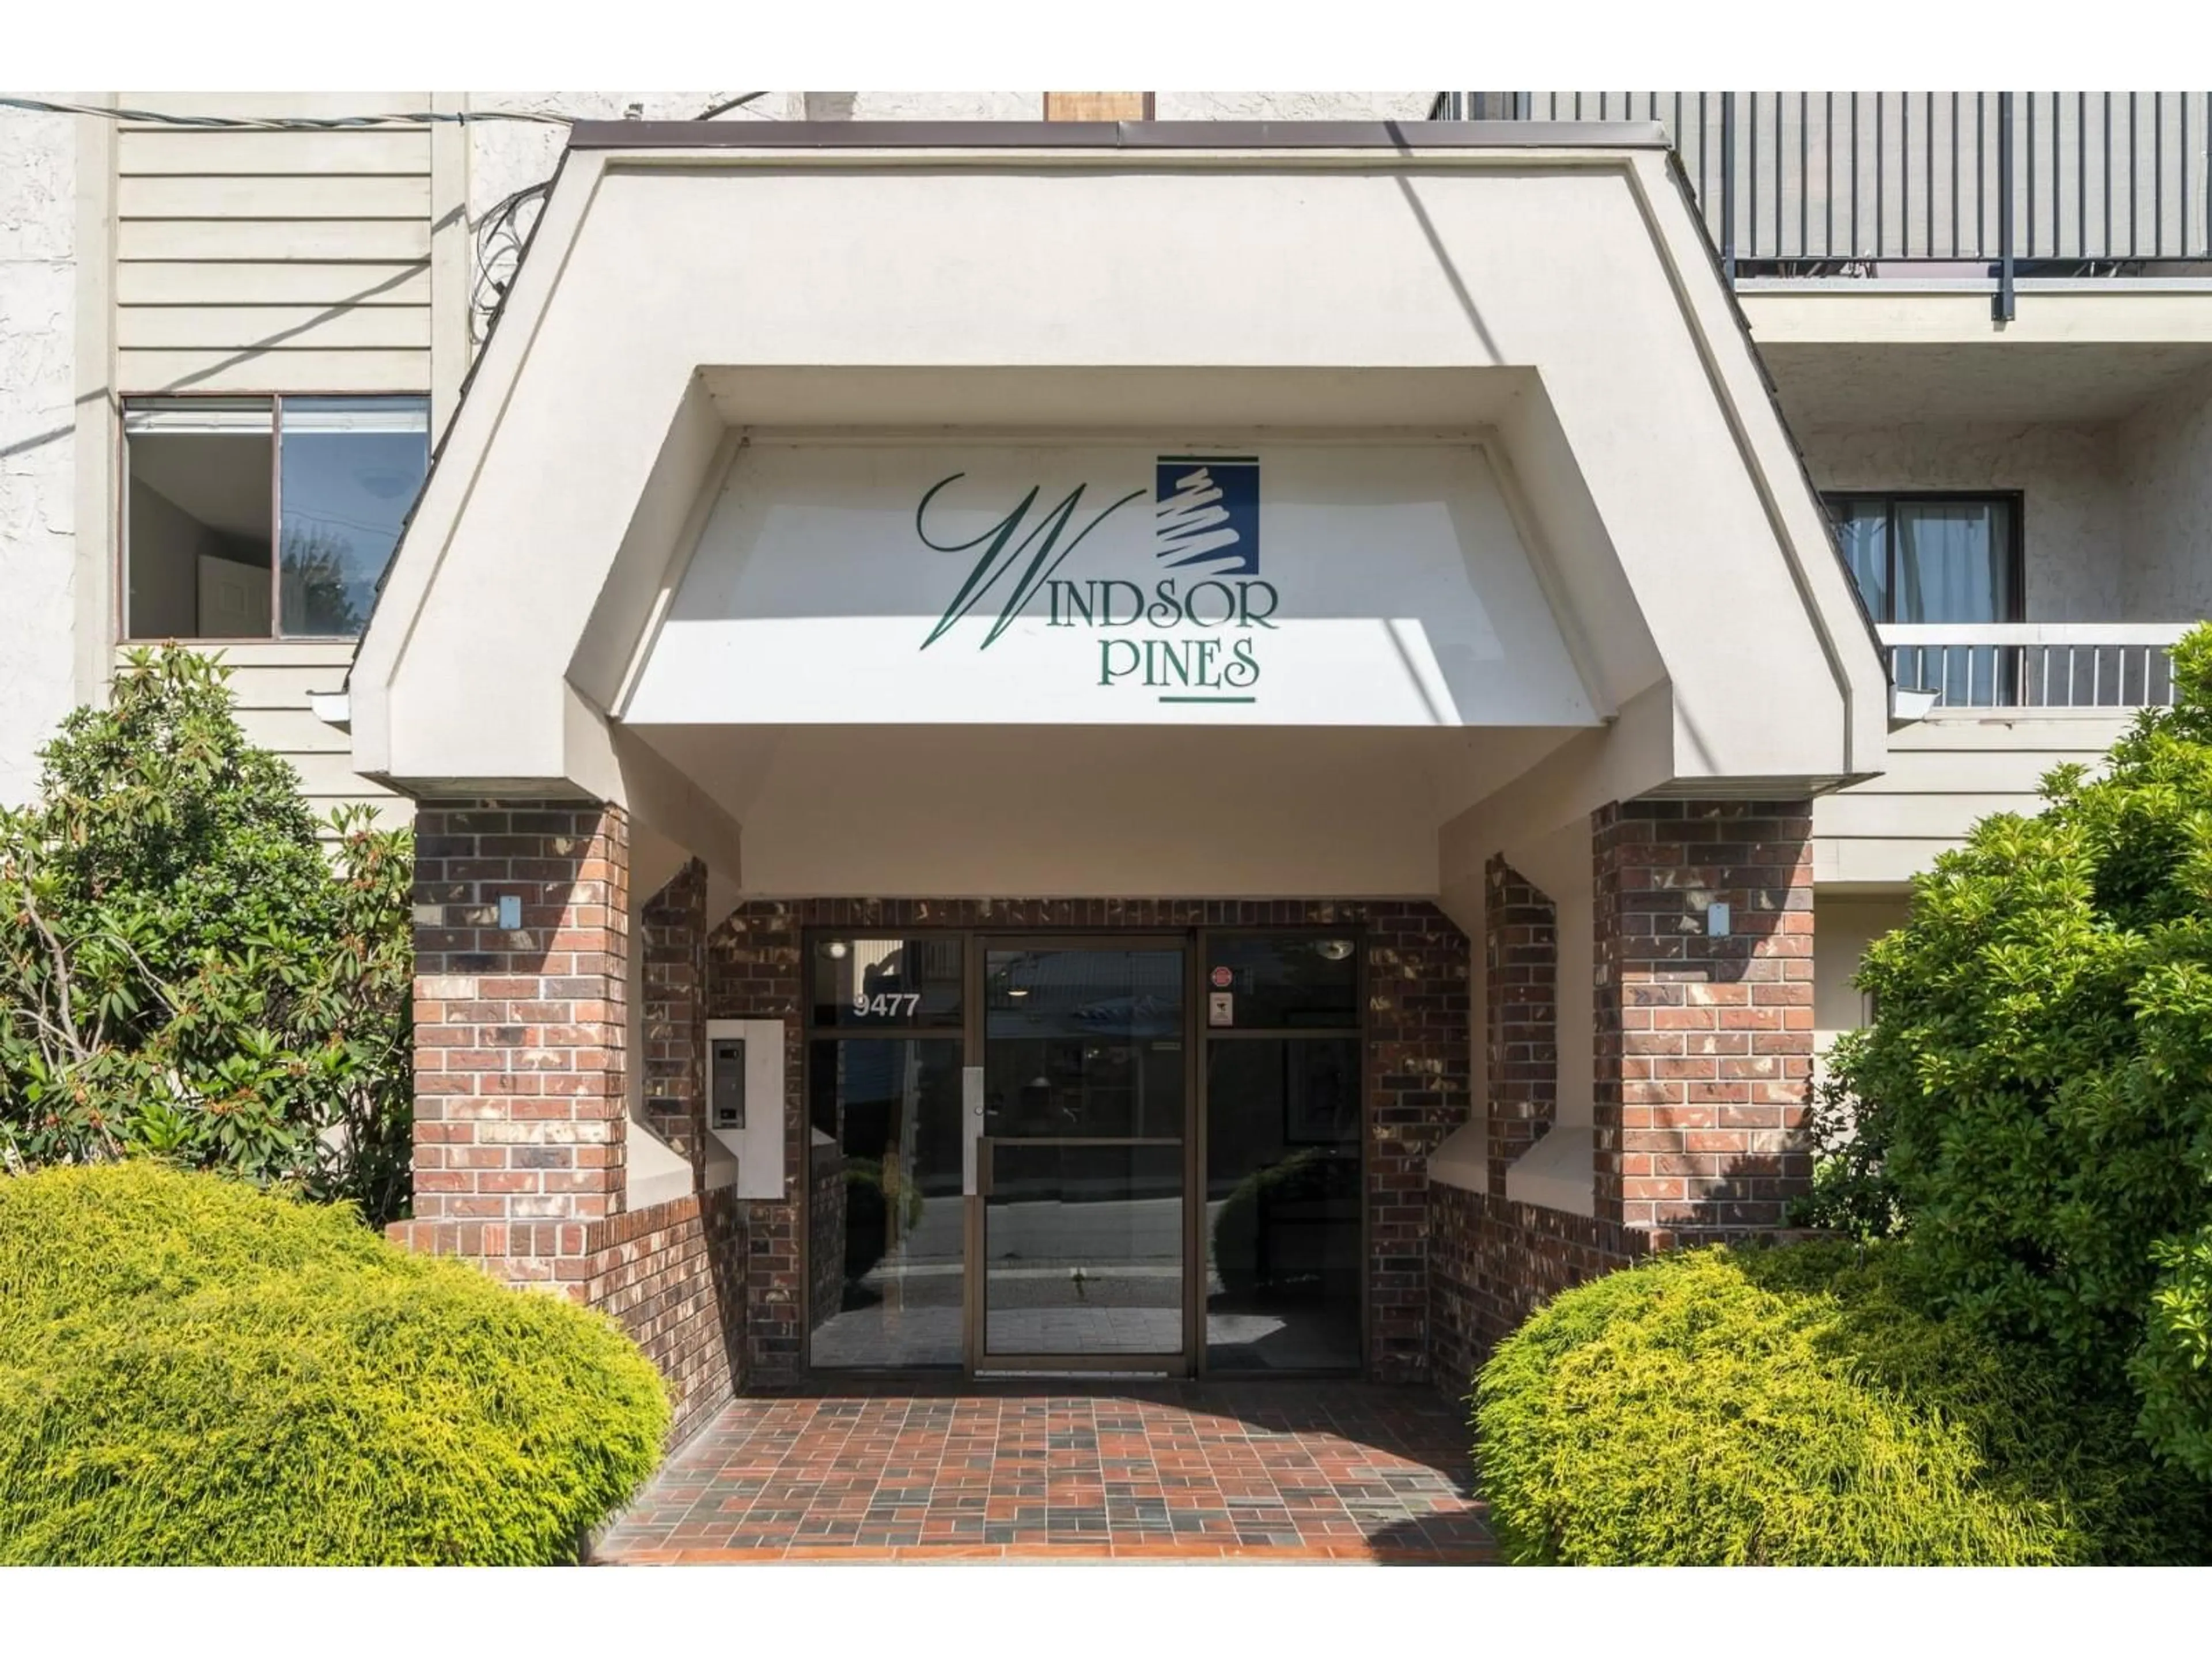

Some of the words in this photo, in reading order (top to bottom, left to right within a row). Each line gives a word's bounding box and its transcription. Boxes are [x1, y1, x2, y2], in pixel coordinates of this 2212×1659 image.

[916, 472, 1280, 651] WINDSOR
[1097, 637, 1260, 689] PINES
[853, 993, 920, 1016] 9477
